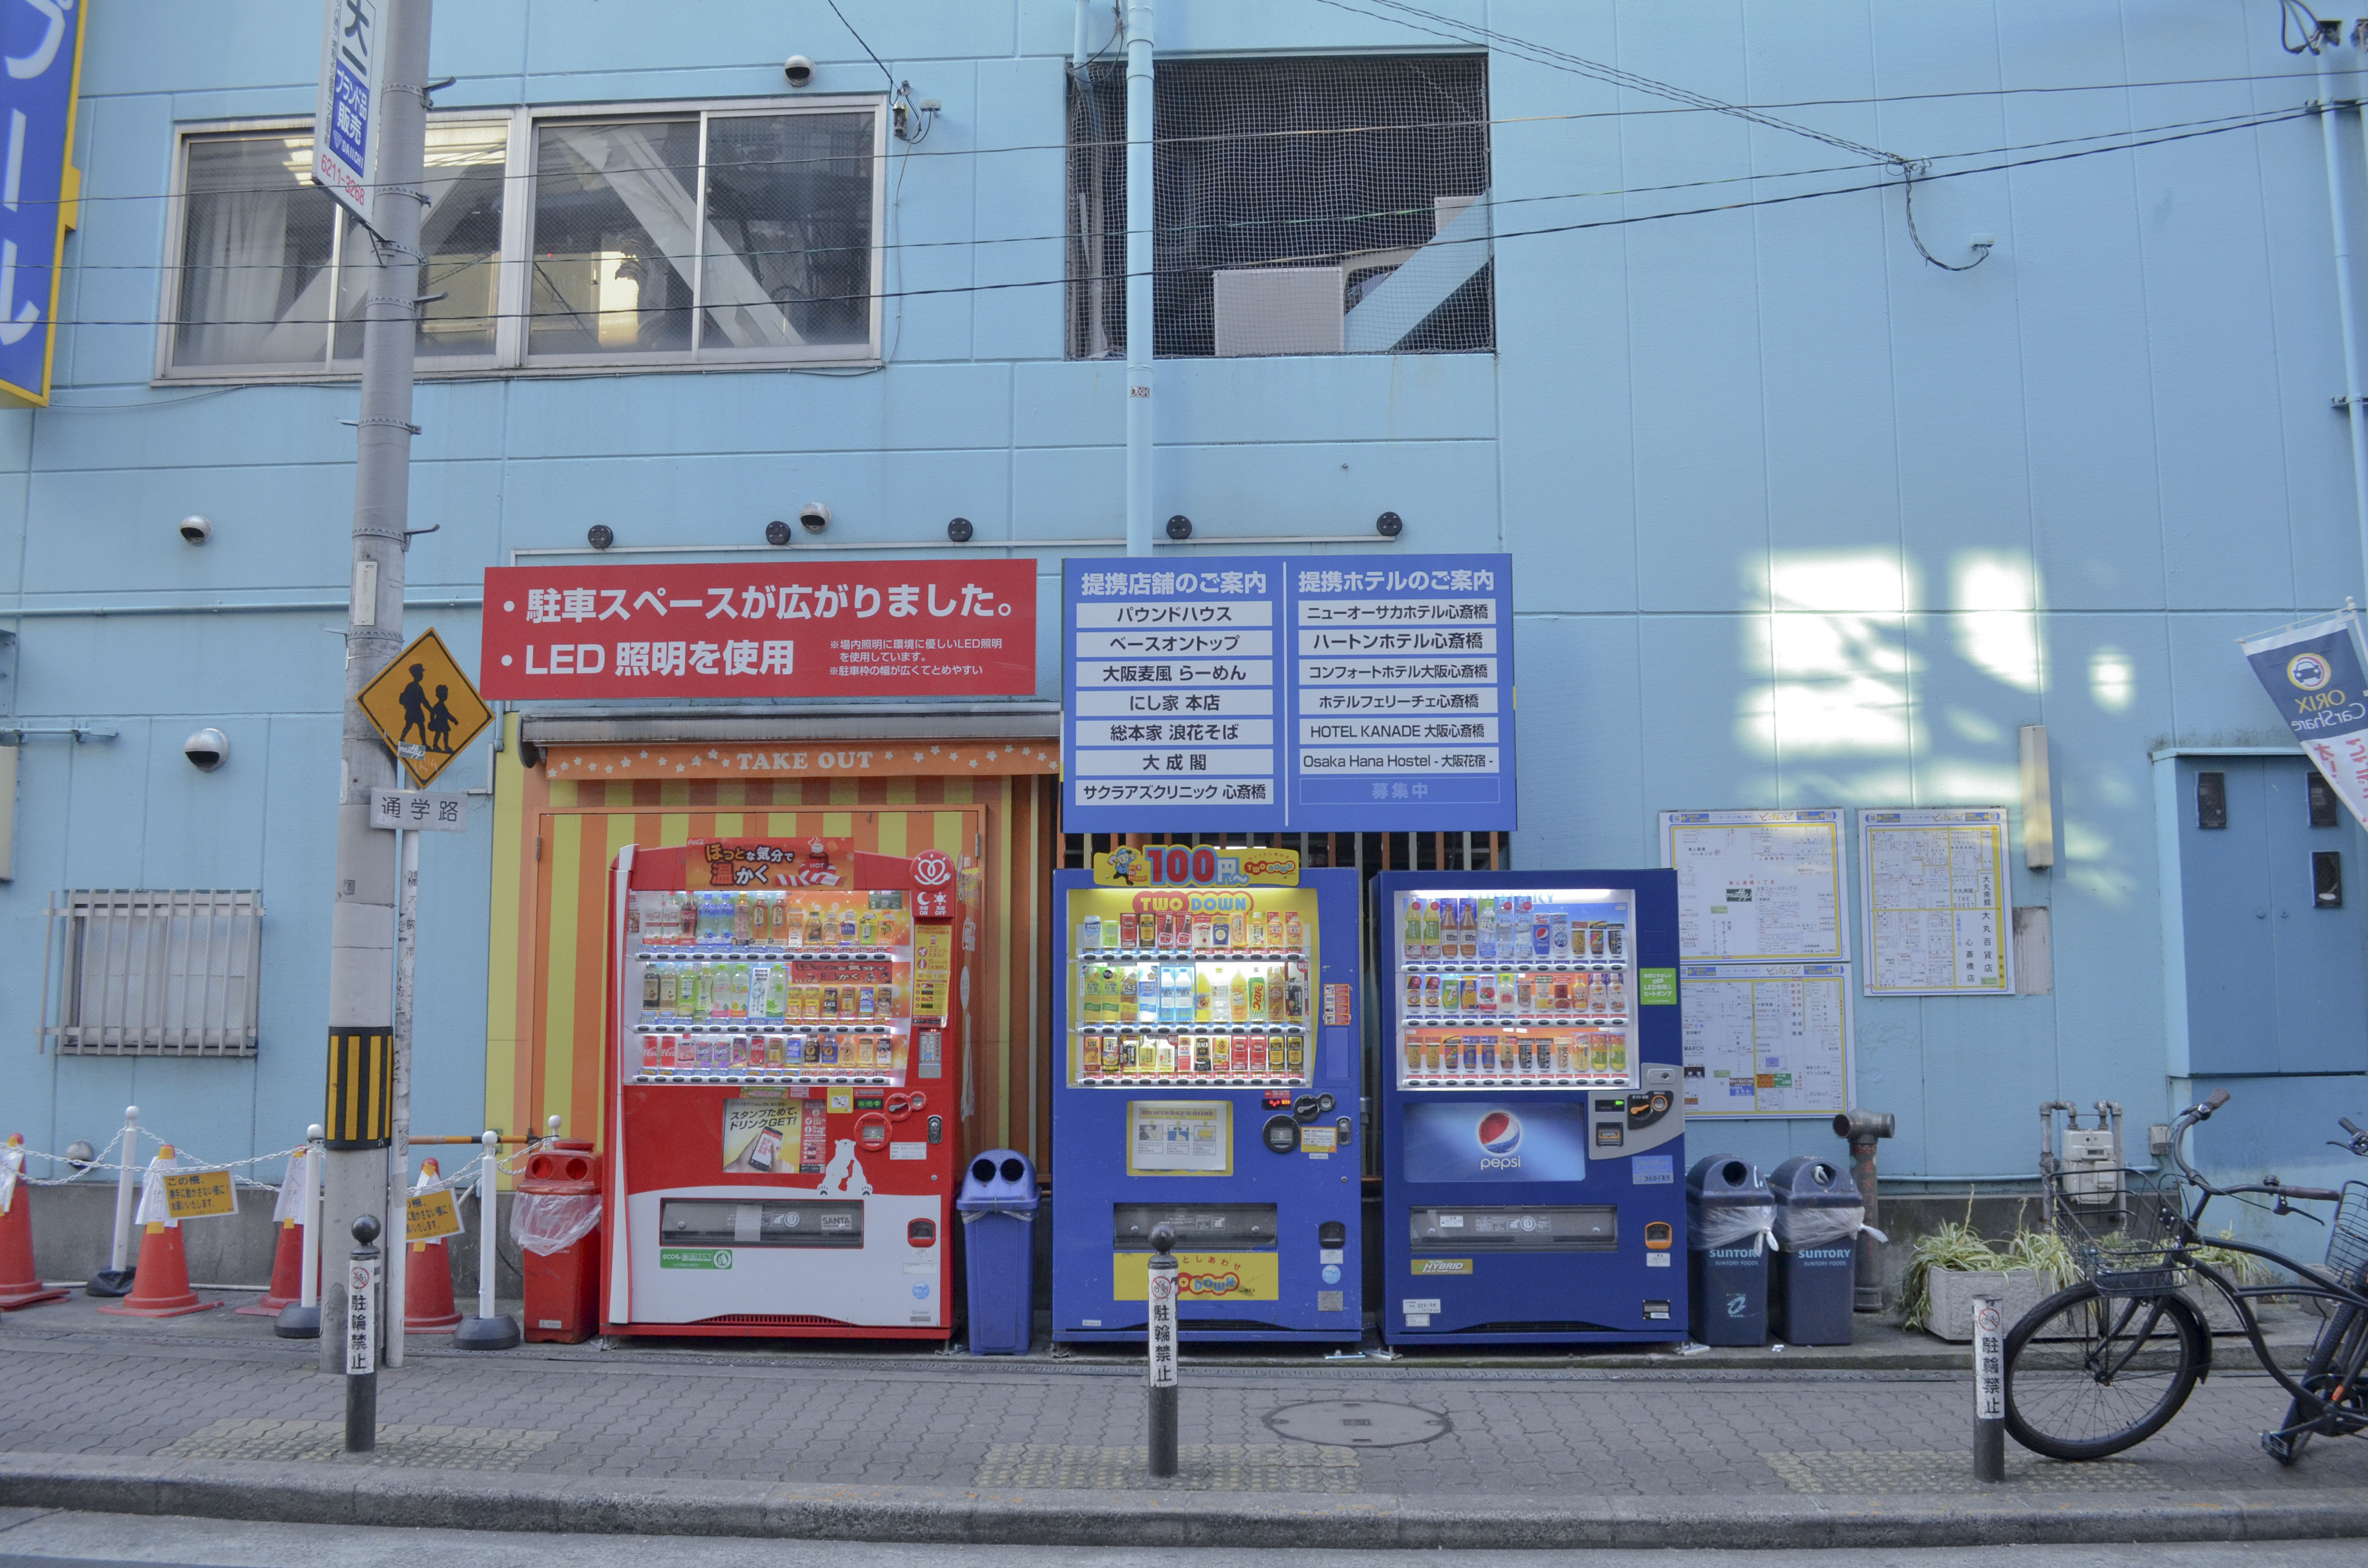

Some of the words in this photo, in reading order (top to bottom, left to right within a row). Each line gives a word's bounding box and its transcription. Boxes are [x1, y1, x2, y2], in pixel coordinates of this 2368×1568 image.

[338, 102, 361, 146] 販売
[342, 142, 364, 169] DAIICHI
[321, 154, 365, 206] 6211-3268
[1081, 571, 1267, 597] 提携店舗のご案内
[1299, 570, 1494, 593] 提携ホテルのご案内
[526, 584, 1011, 624] 駐車スペースが広がりました。
[1307, 603, 1488, 620] ニューオーサカホテル心斎橋
[1117, 606, 1232, 622] パウンドハウス
[1110, 635, 1240, 651] ベースオントップ
[1313, 632, 1483, 650] ハートンホテル心斎橋
[526, 644, 605, 675] LED
[616, 640, 794, 676] 照明を使用
[839, 652, 926, 662] を使用しています。
[1103, 666, 1172, 682] 大阪麦風
[1179, 665, 1246, 681] らーめん
[1309, 663, 1488, 679] コンフォートホテル大阪心斎橋
[1129, 695, 1179, 711] にし家
[1186, 694, 1220, 711] 本店
[1319, 693, 1479, 709] ホテルフェリーチェ心斎橋
[1110, 724, 1162, 741] 総本家
[1169, 723, 1238, 740] 浪花そば
[1311, 725, 1357, 738] HOTEL
[1361, 724, 1420, 738] KANADE
[1424, 723, 1485, 738] 大阪心斎橋
[737, 753, 807, 771] TAKE
[819, 751, 873, 769] OUT
[1303, 754, 1346, 768] Osaka
[1349, 755, 1384, 767] Hana
[1388, 754, 1430, 767] Hostel
[1084, 784, 1218, 800] サクラアズクリニック
[1222, 784, 1266, 799] 心斎橋
[1372, 783, 1428, 799] 募集中
[382, 797, 458, 822] 通学路
[706, 843, 794, 862] ほっとな気分で
[710, 862, 769, 886] 温かく
[1140, 898, 1183, 911] TWO
[1192, 898, 1246, 911] DOWN
[1982, 912, 1993, 972] 大丸百貨店
[730, 1107, 797, 1120] スタンプためて、
[730, 1117, 796, 1130] ドリンクGET!
[1480, 1156, 1521, 1170] pepsi
[1798, 1249, 1851, 1258] SUNTORY
[1423, 1263, 1463, 1273] HYBRID
[1194, 1277, 1235, 1291] DOWN
[352, 1295, 367, 1369] 駐輪禁止
[1154, 1305, 1172, 1382] 駐輪禁止
[1982, 1337, 2000, 1414] 駐輪禁止
